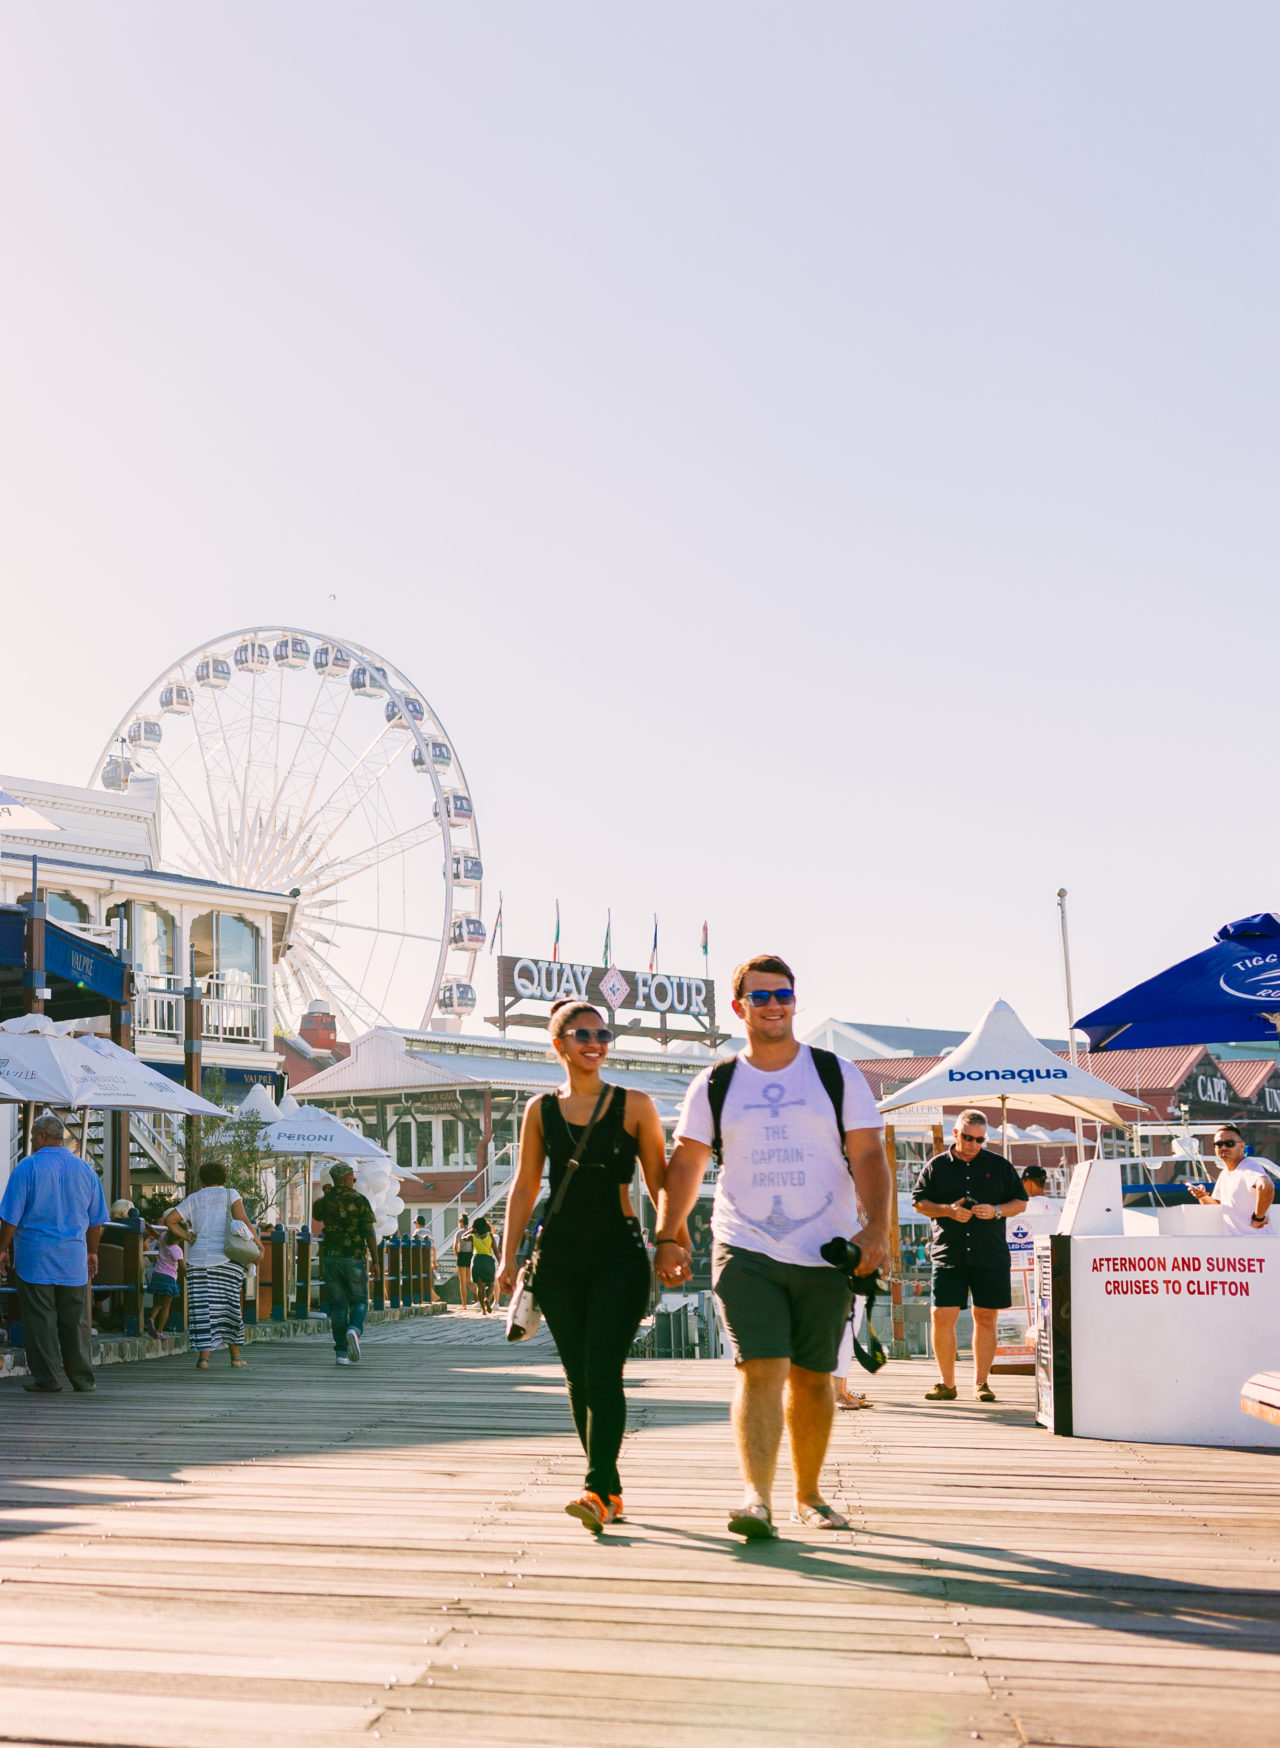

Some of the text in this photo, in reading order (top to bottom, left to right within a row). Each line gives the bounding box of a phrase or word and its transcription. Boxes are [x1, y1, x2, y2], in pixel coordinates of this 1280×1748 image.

[513, 958, 708, 1015] QUAY FOUR
[948, 1068, 1068, 1084] bonaqua
[1197, 1075, 1229, 1106] CAPE
[277, 1132, 334, 1142] PERONI
[763, 1125, 789, 1140] THE
[751, 1171, 806, 1188] ARRIVED
[1092, 1256, 1266, 1273] AFTERNOON AND SUNSET
[1105, 1279, 1250, 1297] CRUISES TO CLIFTON
